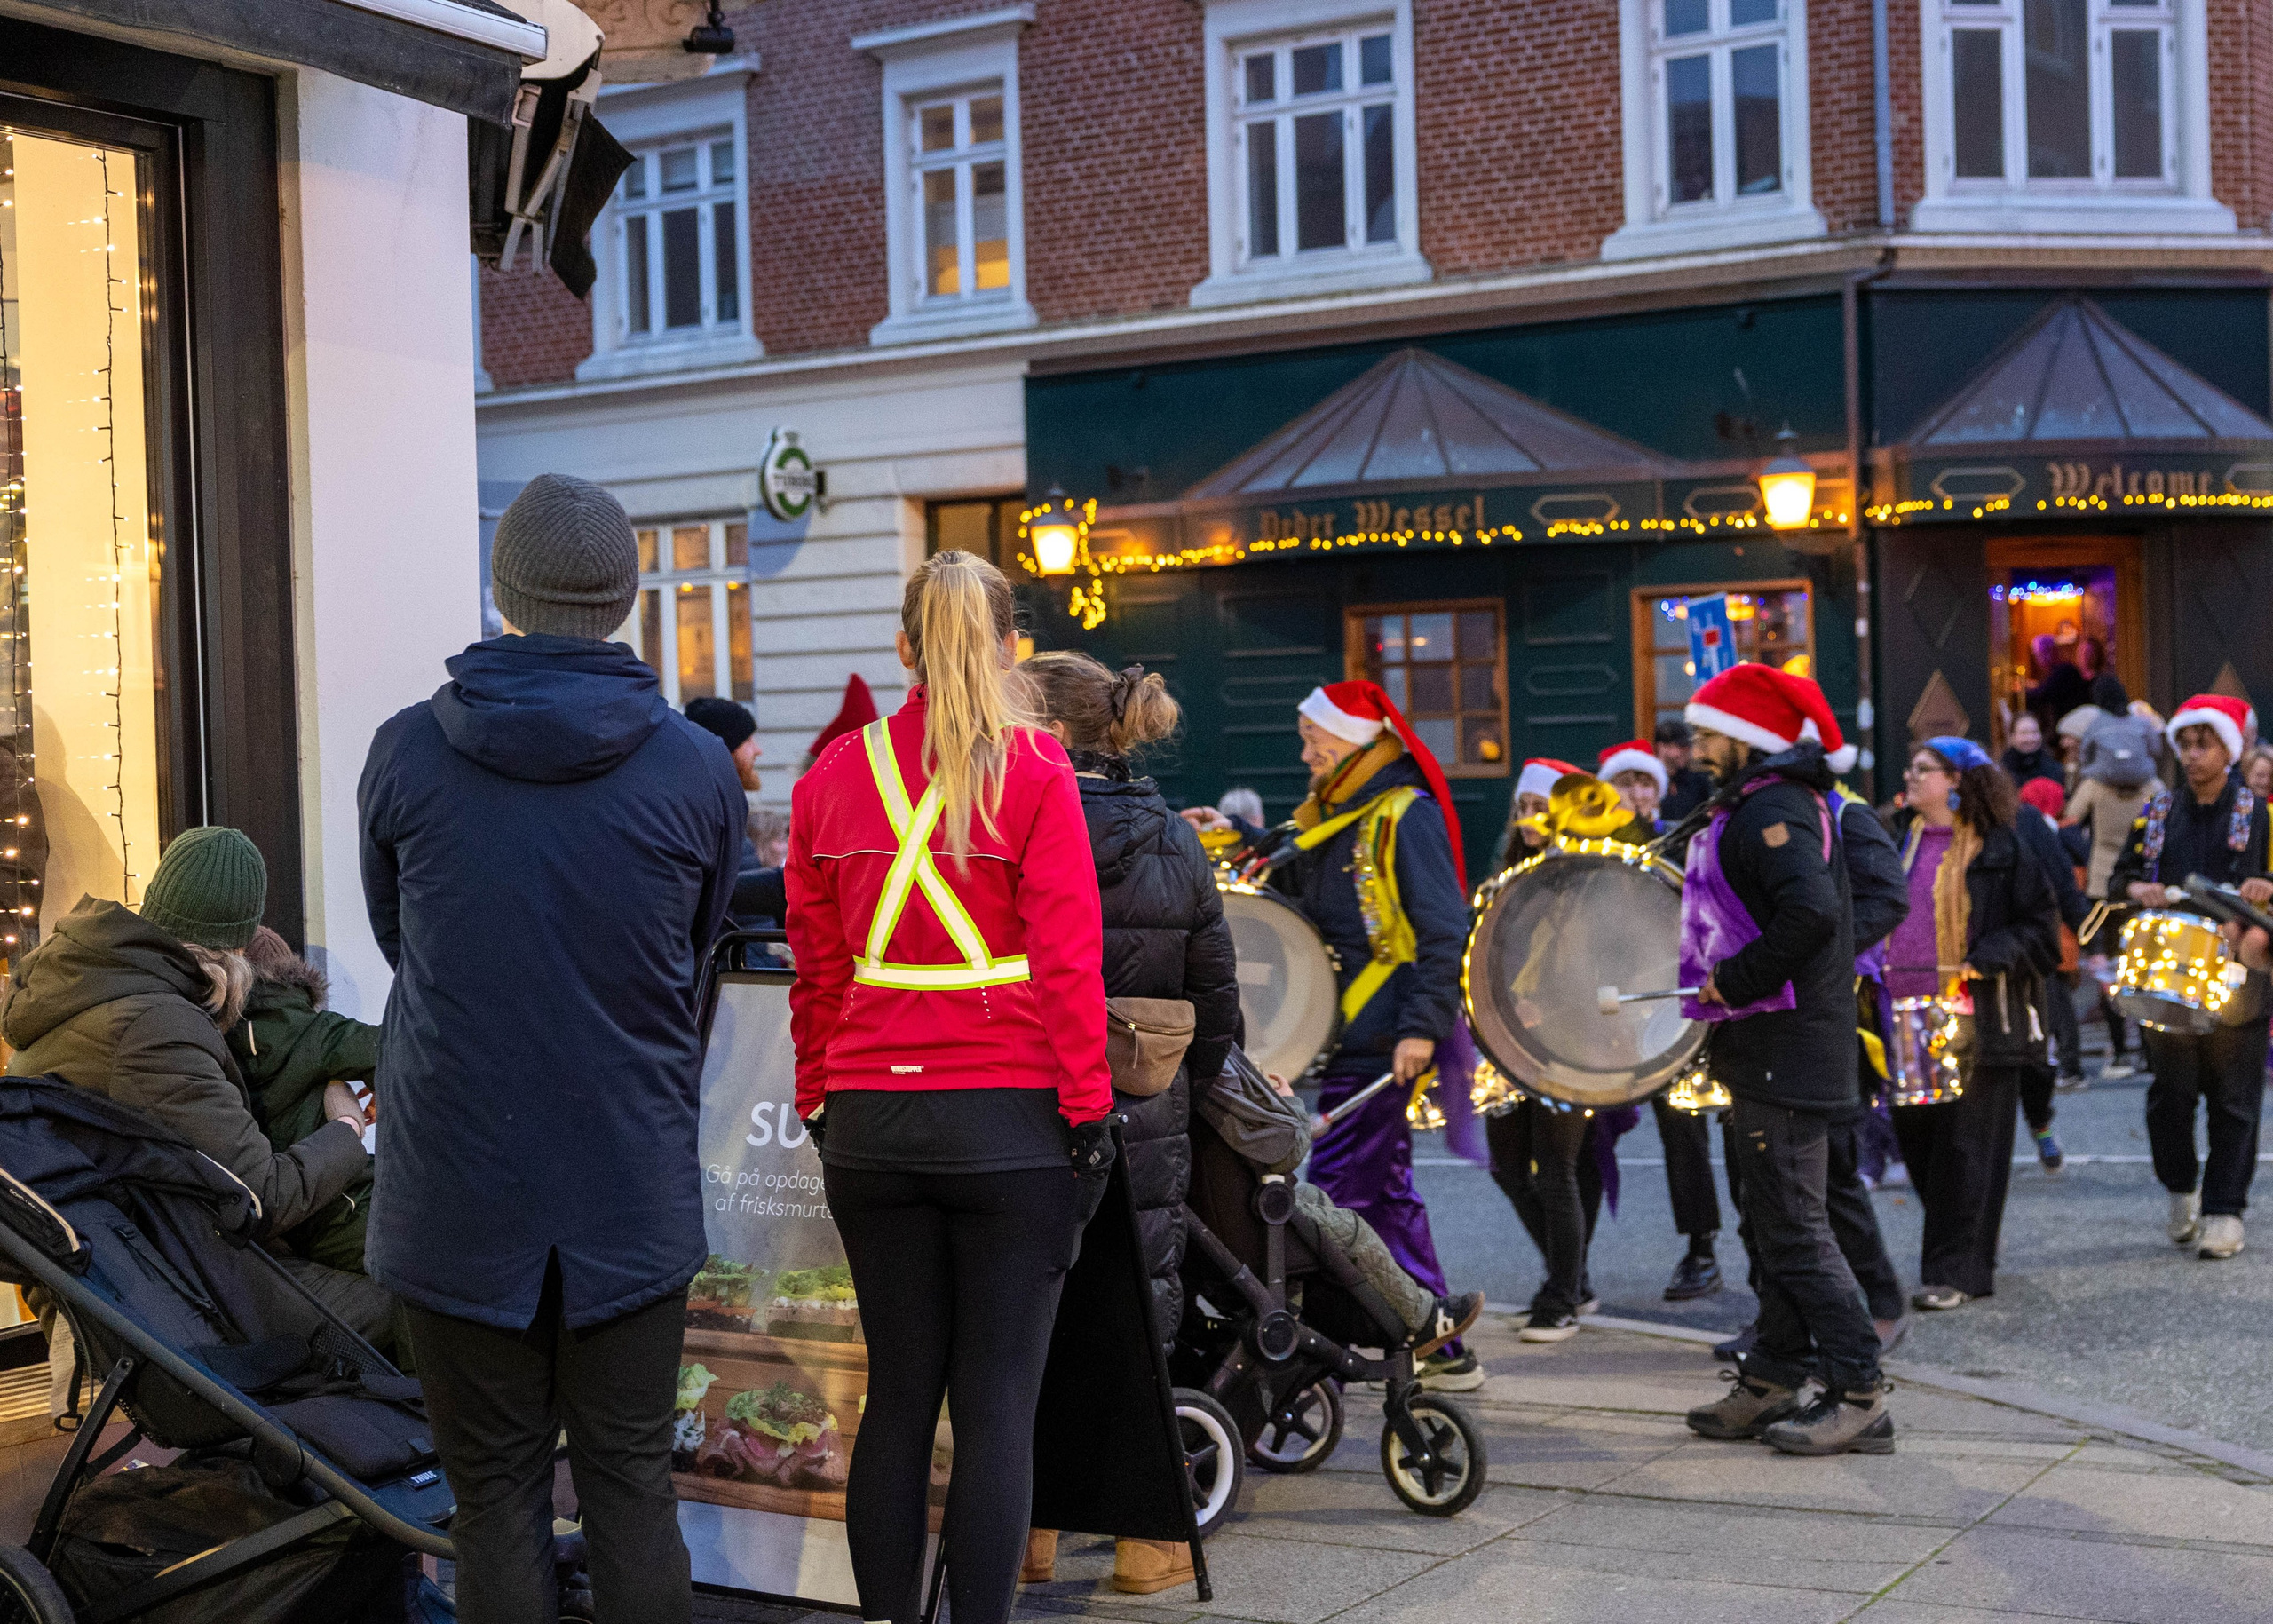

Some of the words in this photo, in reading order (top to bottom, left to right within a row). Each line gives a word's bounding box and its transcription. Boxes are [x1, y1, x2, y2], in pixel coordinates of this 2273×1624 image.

[2048, 463, 2212, 498] Welcome
[1354, 495, 1485, 535] Wessel
[746, 1101, 818, 1150] SU
[706, 1164, 731, 1184] Gå
[735, 1168, 760, 1190] på
[715, 1192, 736, 1212] af
[410, 1470, 437, 1484] THULE
